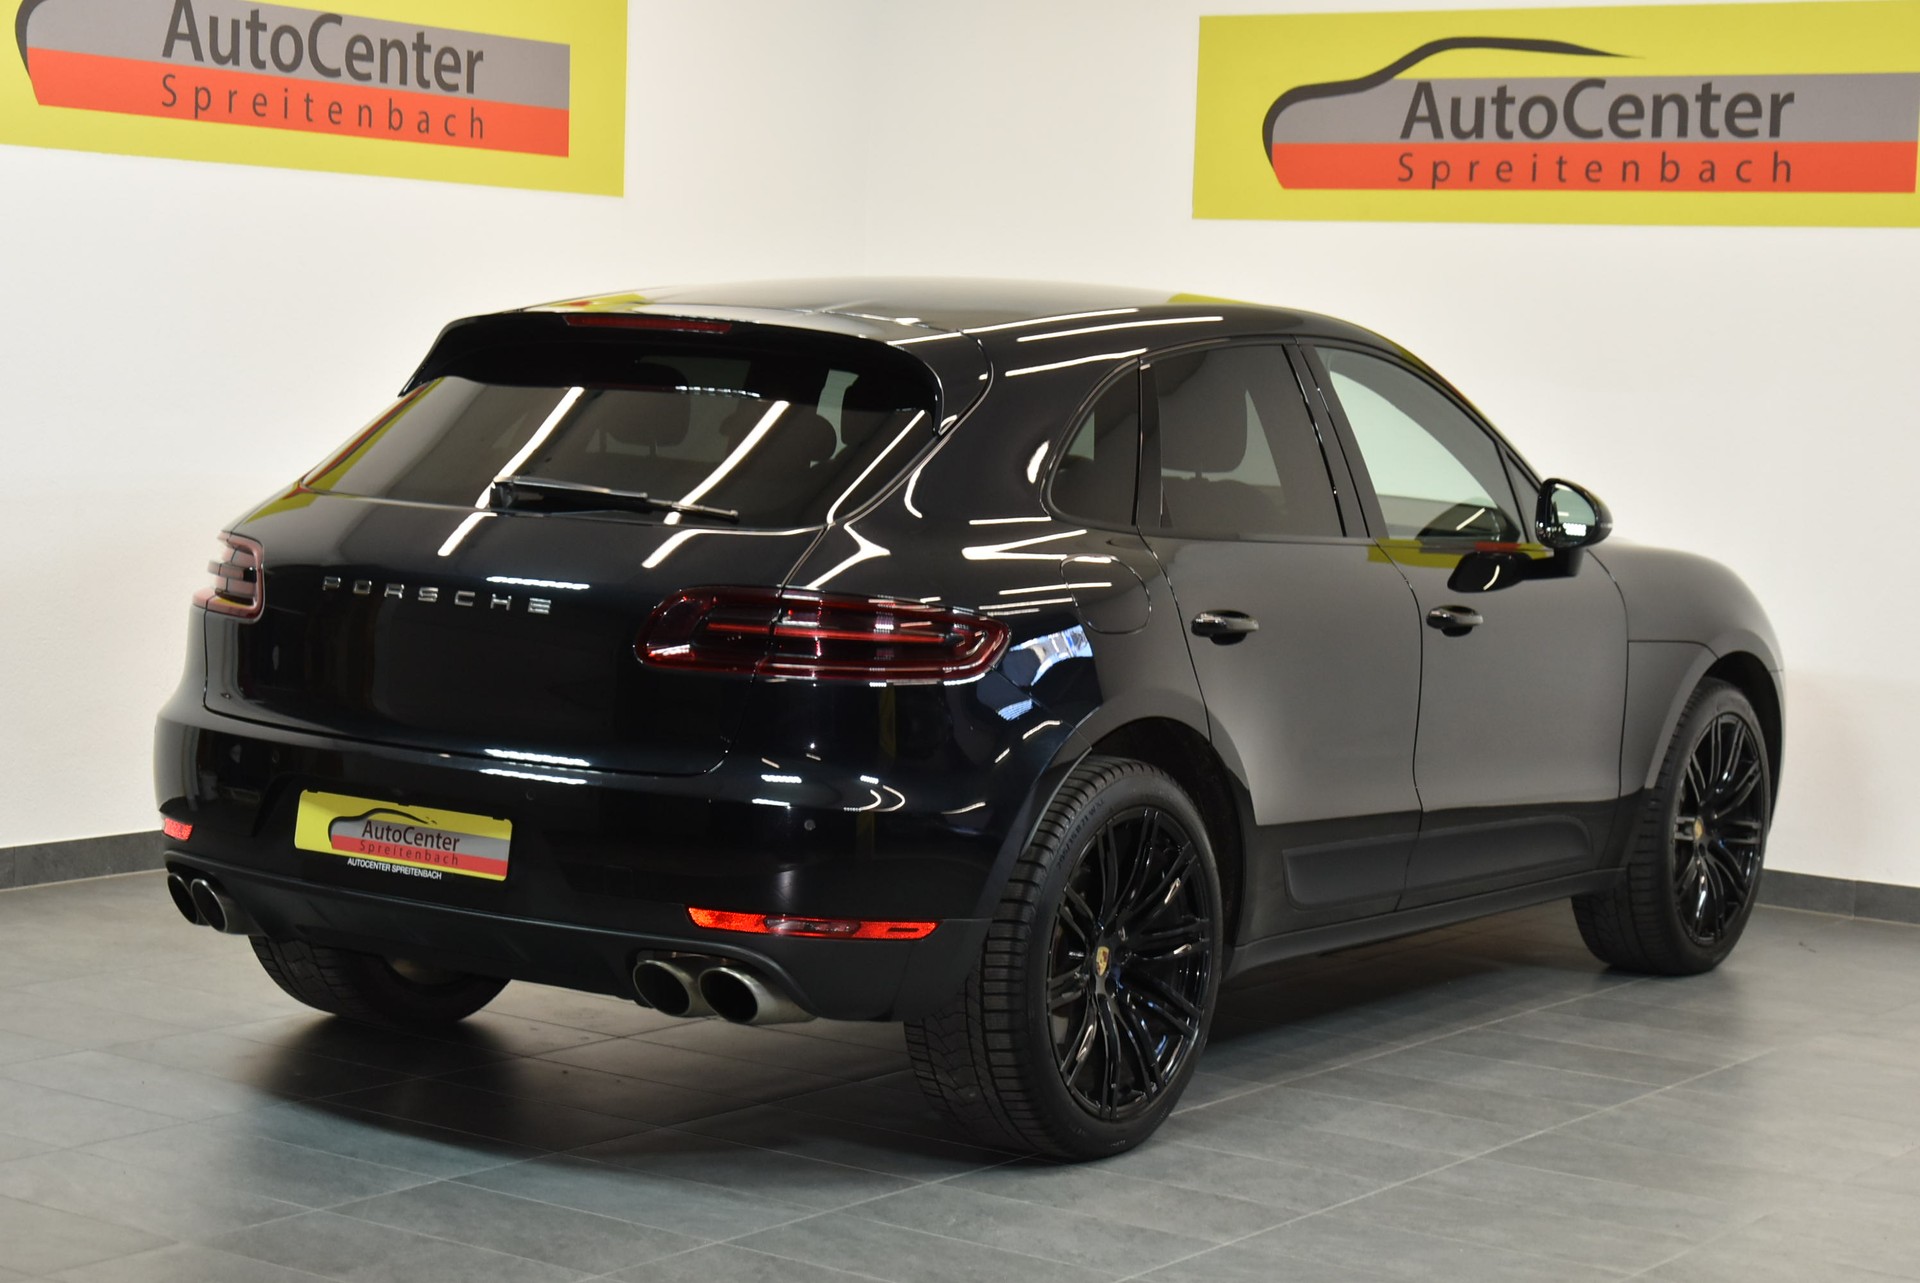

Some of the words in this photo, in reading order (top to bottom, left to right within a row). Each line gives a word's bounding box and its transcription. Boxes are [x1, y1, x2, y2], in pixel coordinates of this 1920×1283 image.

[162, 0, 483, 95] AutoCenter
[161, 73, 484, 139] Spreitenbach
[1400, 78, 1795, 140] AutoCenter
[1398, 150, 1792, 190] Spreitenbach
[323, 576, 551, 614] PORSCHE
[359, 839, 459, 866] Spreitenbach
[361, 820, 460, 852] AutoCenter
[347, 857, 391, 873] AUTOCENTER
[391, 864, 442, 880] SPREITENBACH
